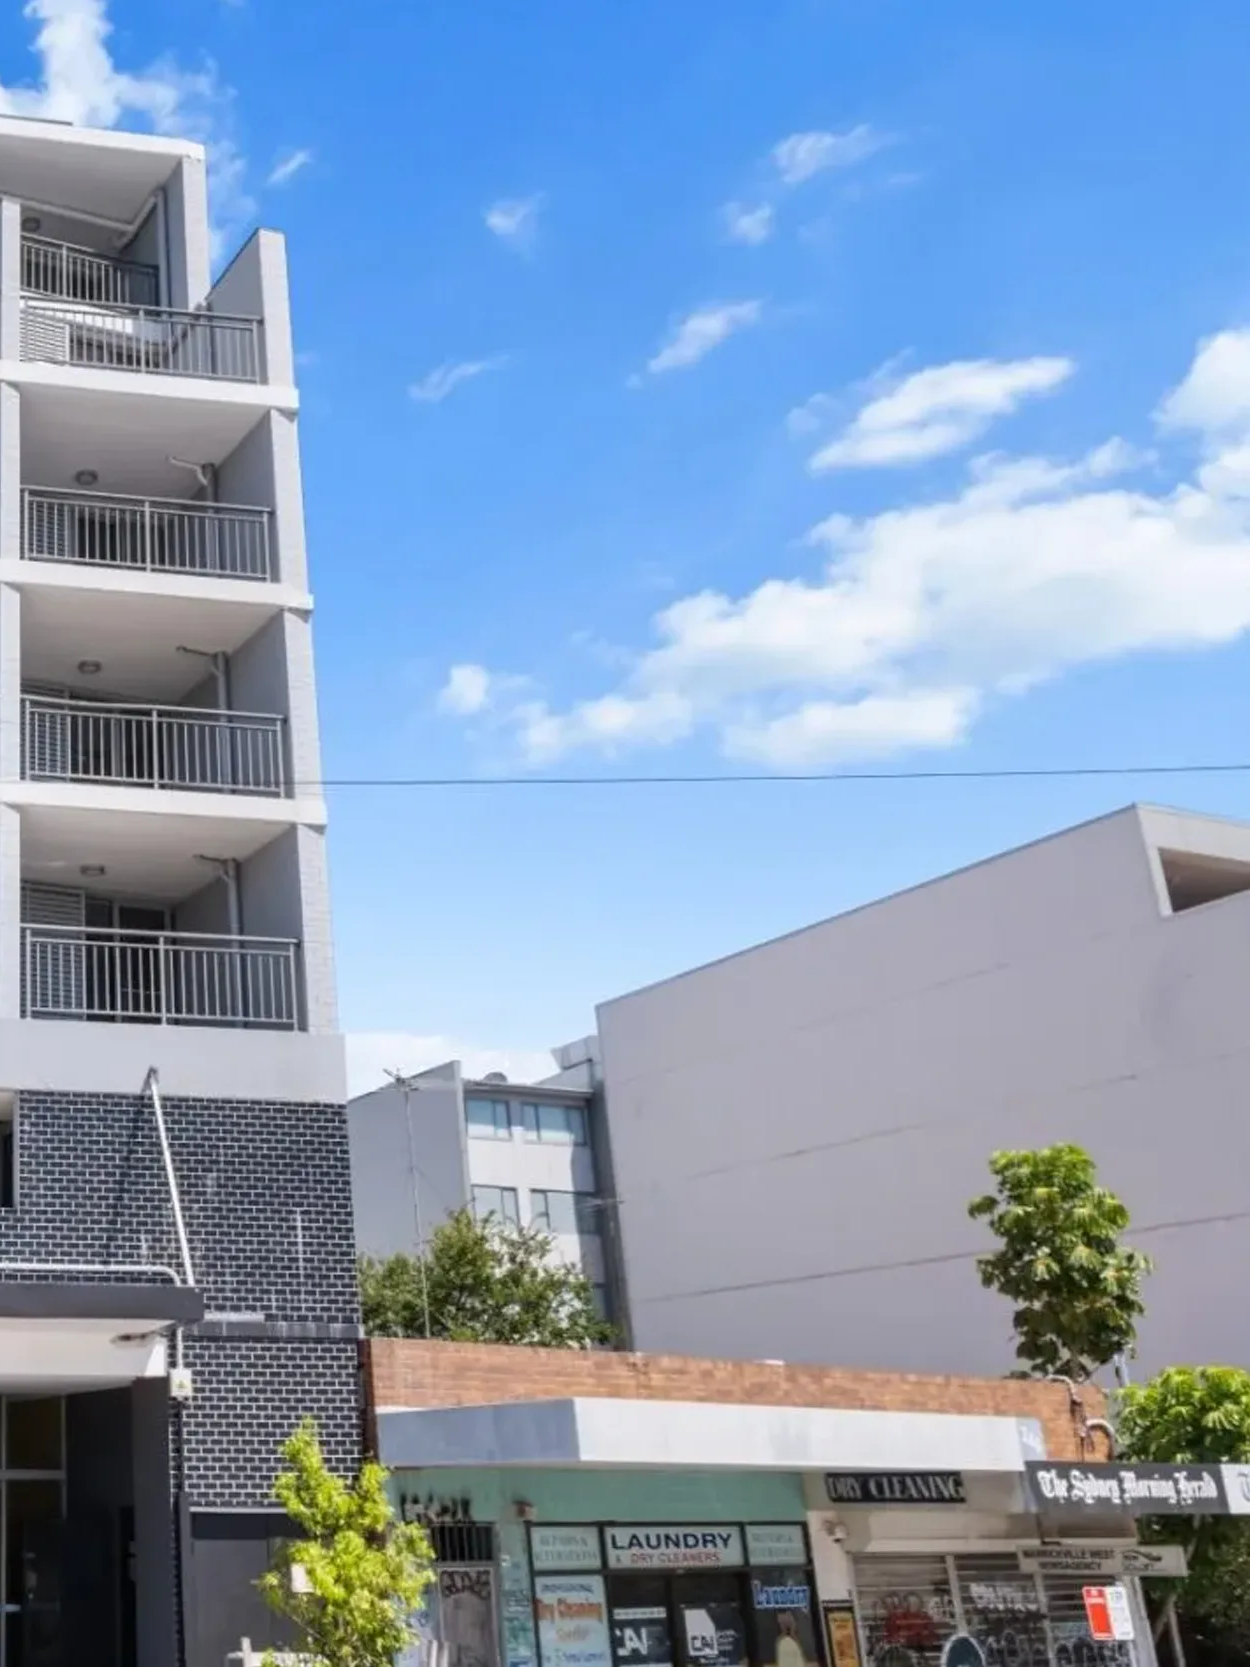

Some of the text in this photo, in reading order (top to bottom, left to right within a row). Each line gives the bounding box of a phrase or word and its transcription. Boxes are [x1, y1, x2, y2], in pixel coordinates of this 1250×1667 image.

[827, 1475, 966, 1500] DRY CLEANING
[1036, 1469, 1069, 1503] The
[1069, 1469, 1122, 1504] Sydney
[1119, 1470, 1177, 1504] Morning
[1174, 1470, 1219, 1505] Herald
[611, 1532, 733, 1550] LAUNDRY
[630, 1552, 654, 1565] DRY
[658, 1551, 721, 1564] CLEANERS
